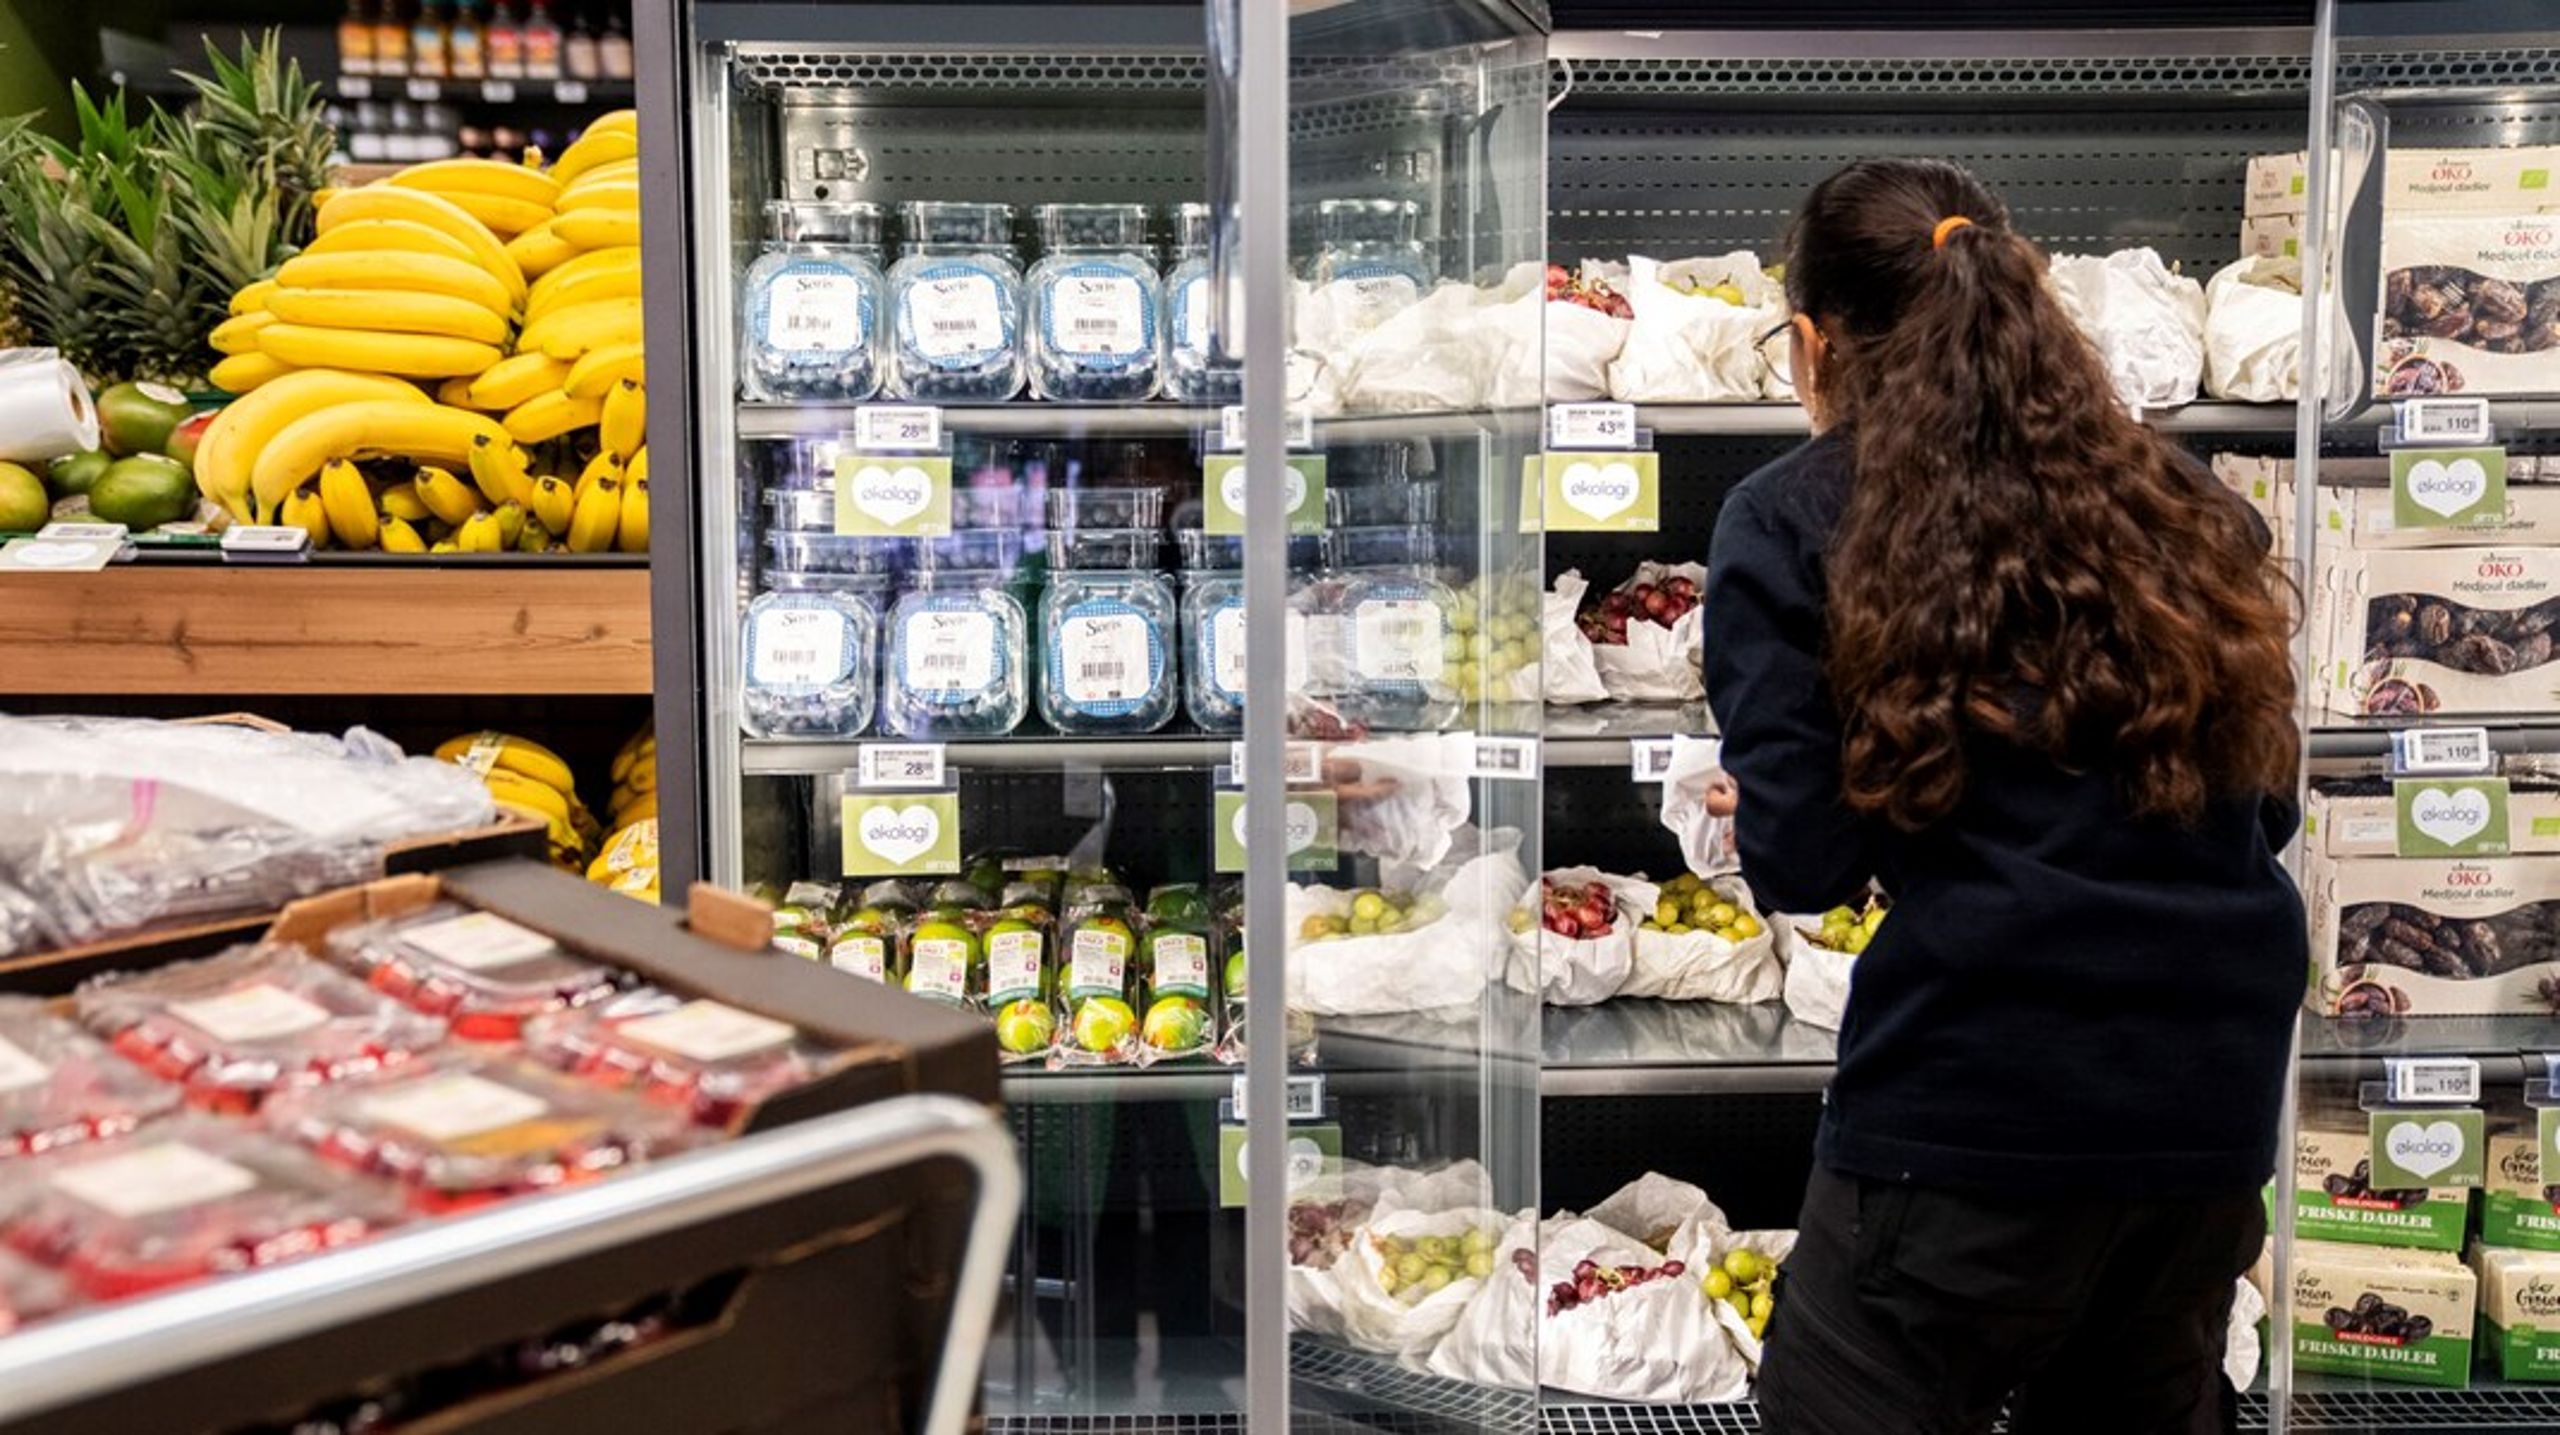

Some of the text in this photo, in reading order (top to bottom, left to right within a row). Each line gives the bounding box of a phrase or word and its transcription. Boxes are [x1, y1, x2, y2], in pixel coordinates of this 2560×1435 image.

[2506, 579, 2547, 591] dadler
[2298, 1205, 2432, 1228] FRISKE DADLER
[2299, 1338, 2361, 1357] FRISKE
[2365, 1346, 2437, 1365] DADLER
